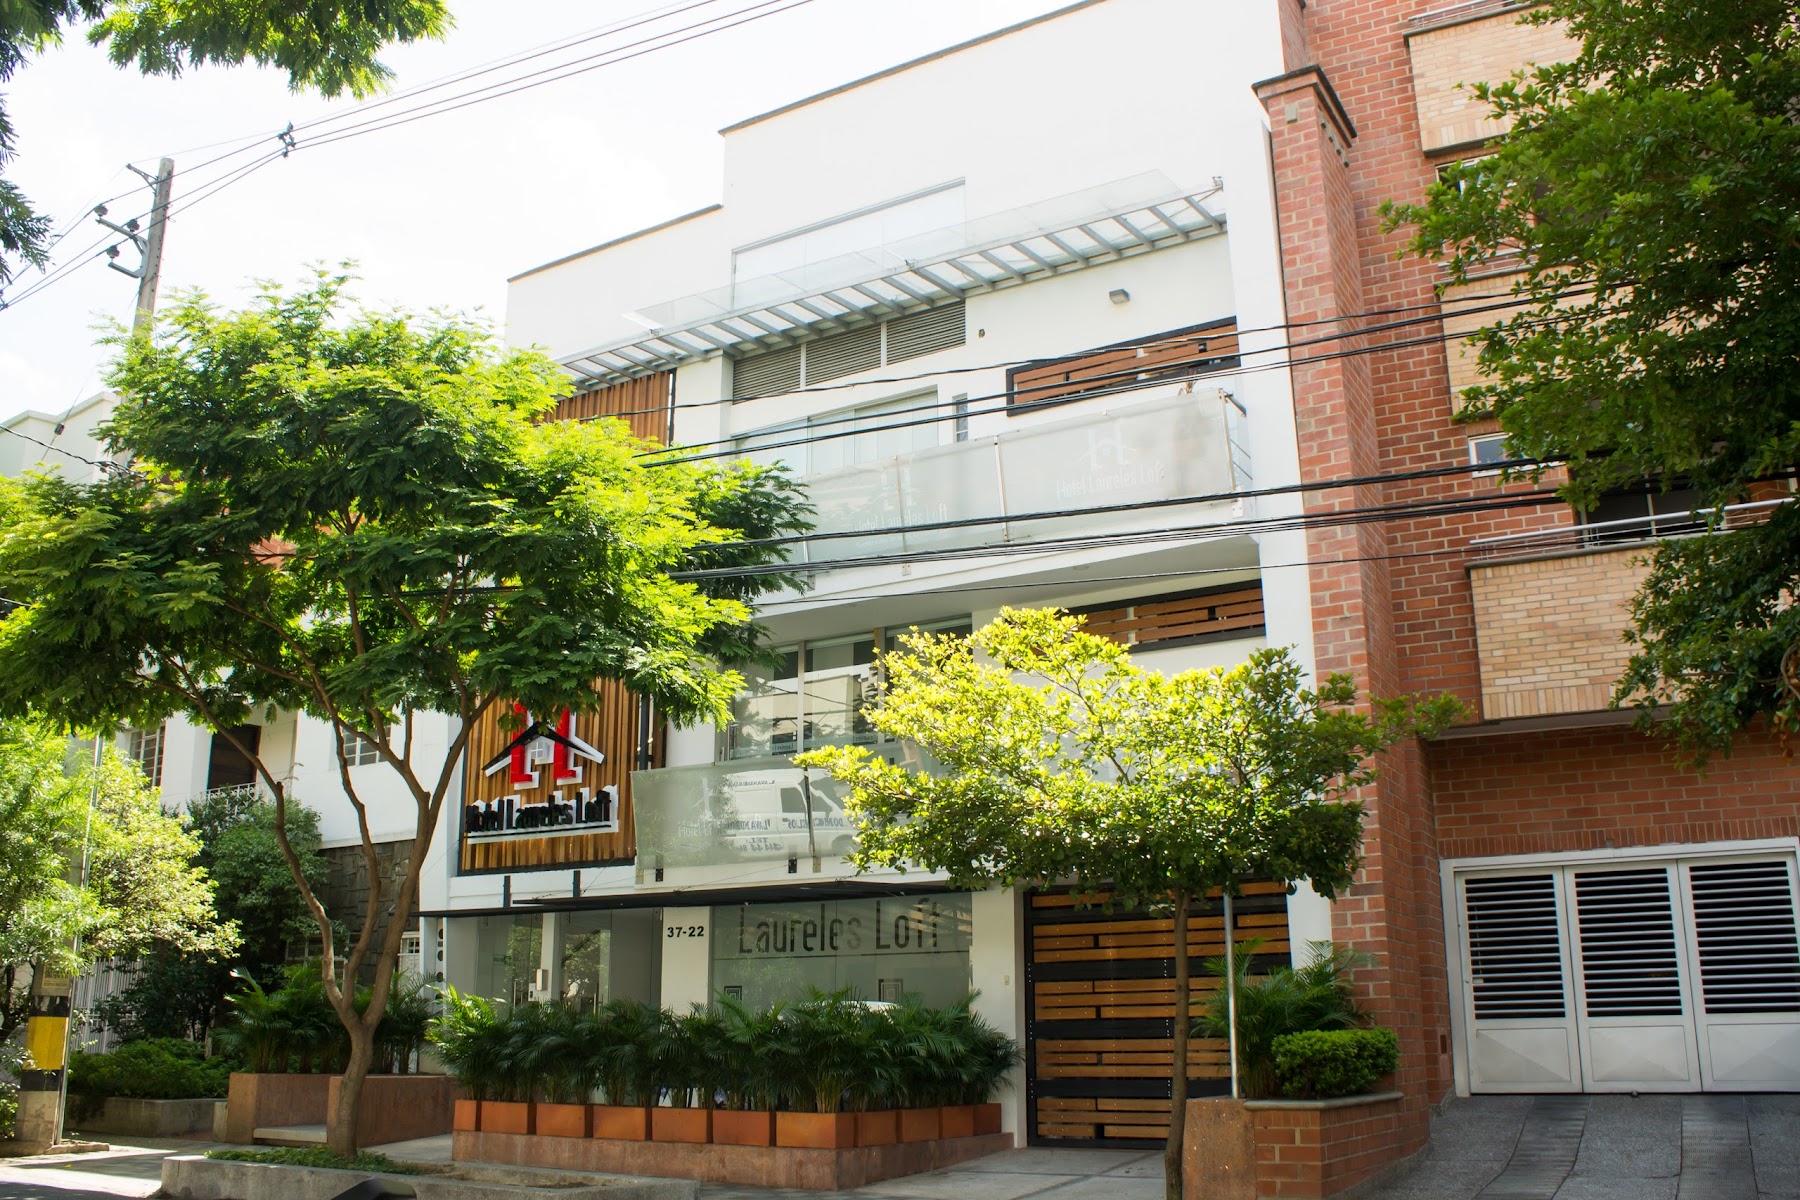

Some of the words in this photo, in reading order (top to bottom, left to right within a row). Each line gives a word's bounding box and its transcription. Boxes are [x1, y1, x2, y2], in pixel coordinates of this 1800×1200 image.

[667, 925, 705, 938] 37-22
[738, 903, 863, 954] Laureles
[874, 896, 941, 950] Loft
